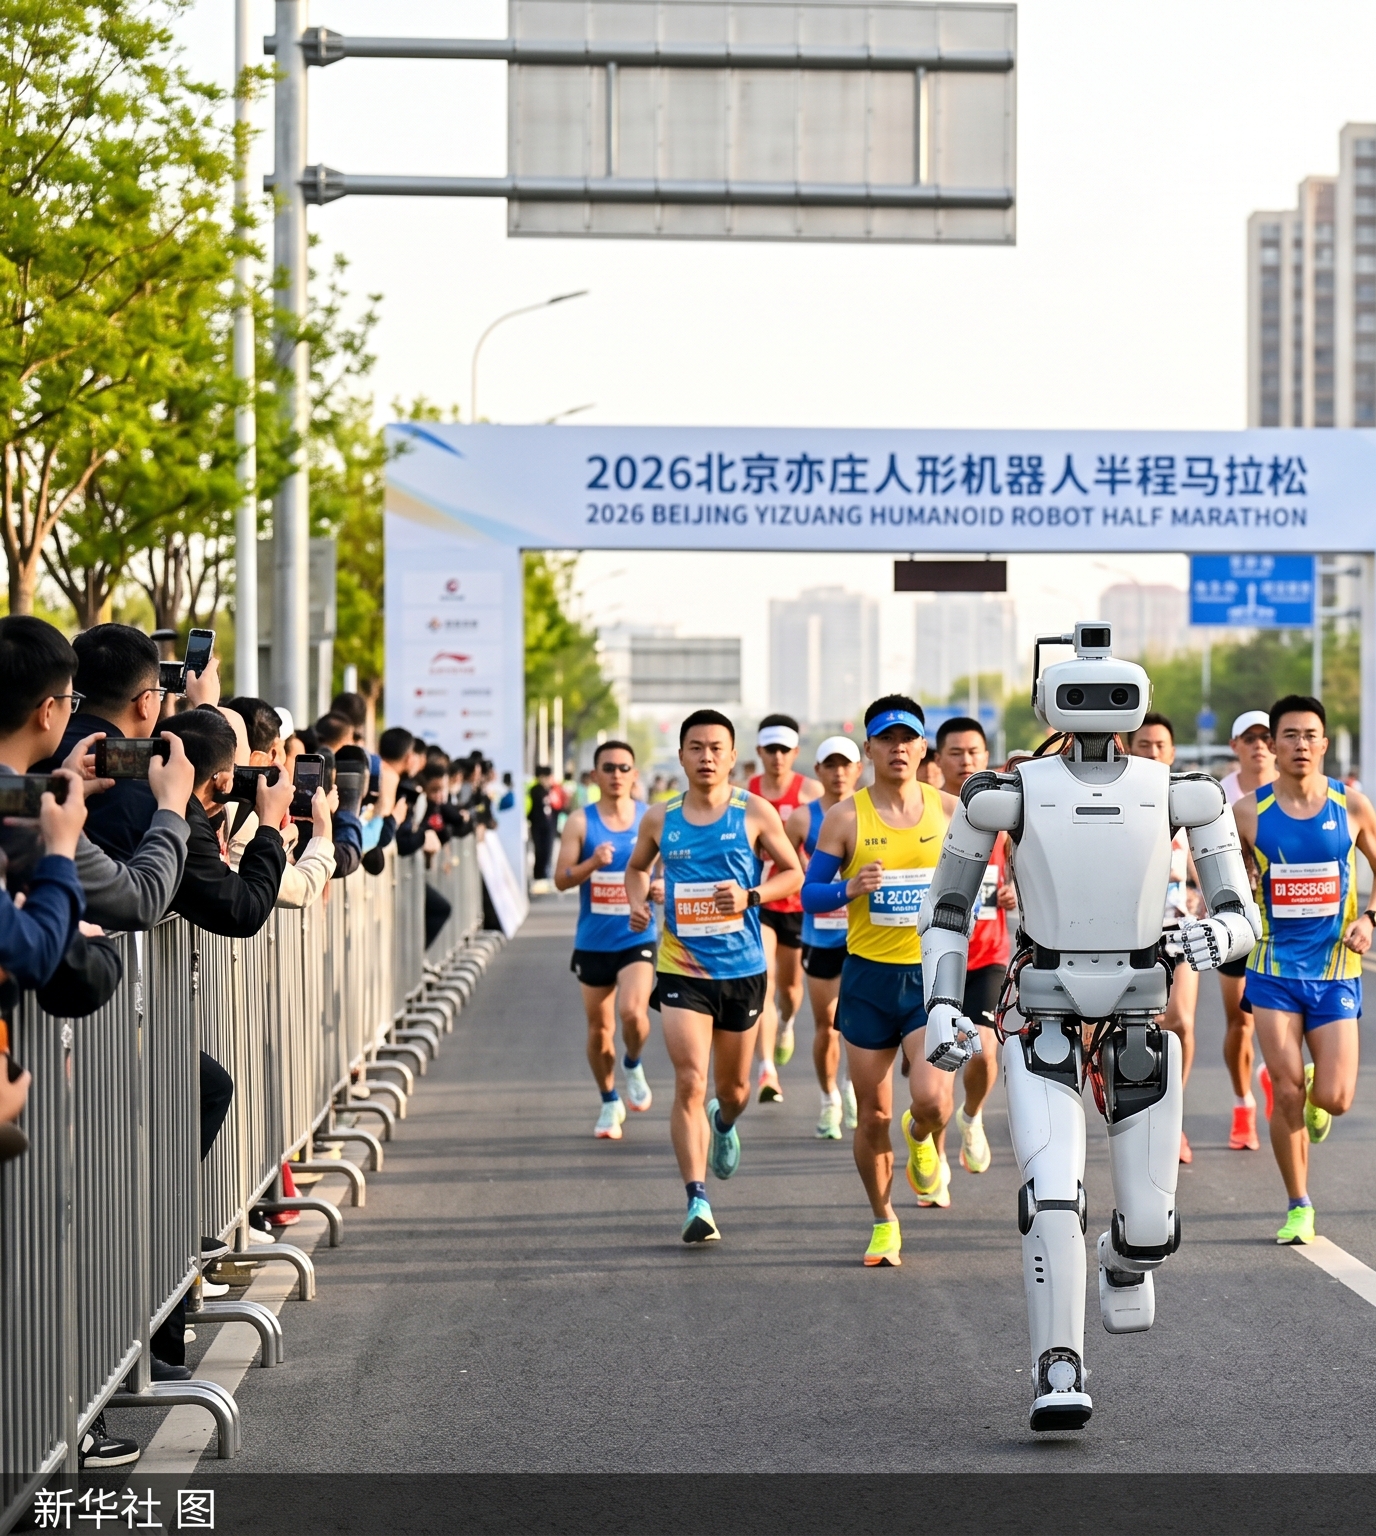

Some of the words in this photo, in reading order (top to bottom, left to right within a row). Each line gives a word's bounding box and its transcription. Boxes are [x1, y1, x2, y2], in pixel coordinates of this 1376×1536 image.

[586, 452, 1307, 497] 2026北京亦庄人形机器人半程马拉松
[587, 504, 644, 524] 2026
[652, 504, 748, 525] BEIJING
[756, 505, 862, 525] YIZUANG
[870, 506, 1004, 526] HUMANOID
[1012, 506, 1094, 526] ROBOT
[1103, 507, 1161, 526] HALF
[1172, 507, 1306, 527] MARATHON
